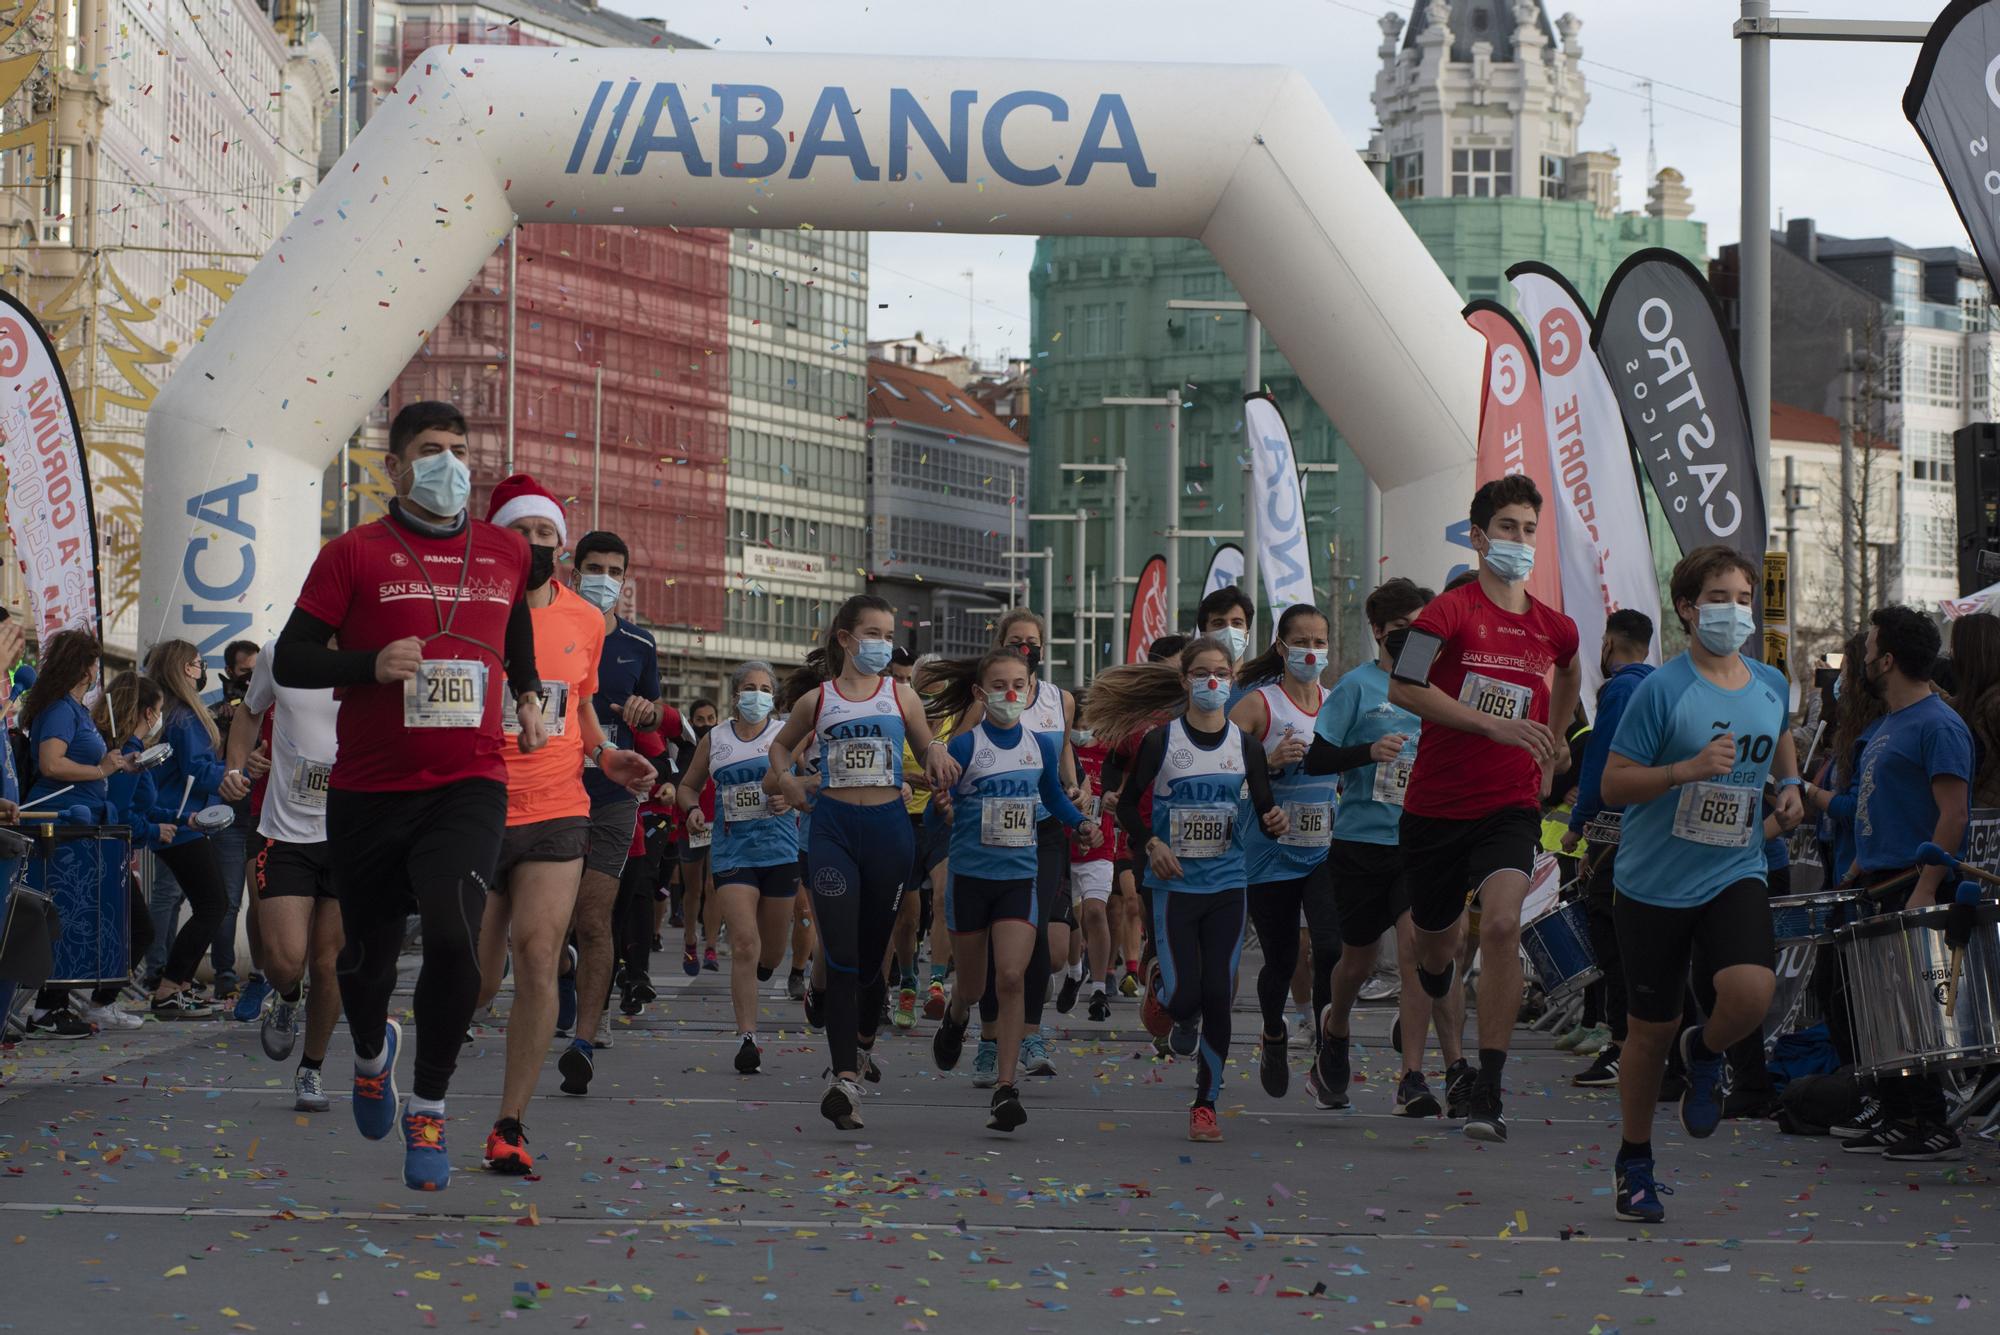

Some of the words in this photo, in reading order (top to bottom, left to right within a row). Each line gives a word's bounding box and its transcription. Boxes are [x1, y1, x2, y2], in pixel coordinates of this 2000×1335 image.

[423, 554, 464, 564] ABANCA
[379, 583, 406, 598] SAN
[1462, 651, 1482, 663] SAN
[1483, 653, 1526, 668] SILVESTRE
[427, 677, 474, 703] 2160
[1476, 691, 1517, 719] 1093
[845, 750, 875, 769] 557
[736, 791, 761, 808] 558
[1004, 811, 1027, 830] 514
[1700, 799, 1739, 826] 683
[1183, 821, 1222, 841] 2688
[1300, 814, 1322, 832] 516
